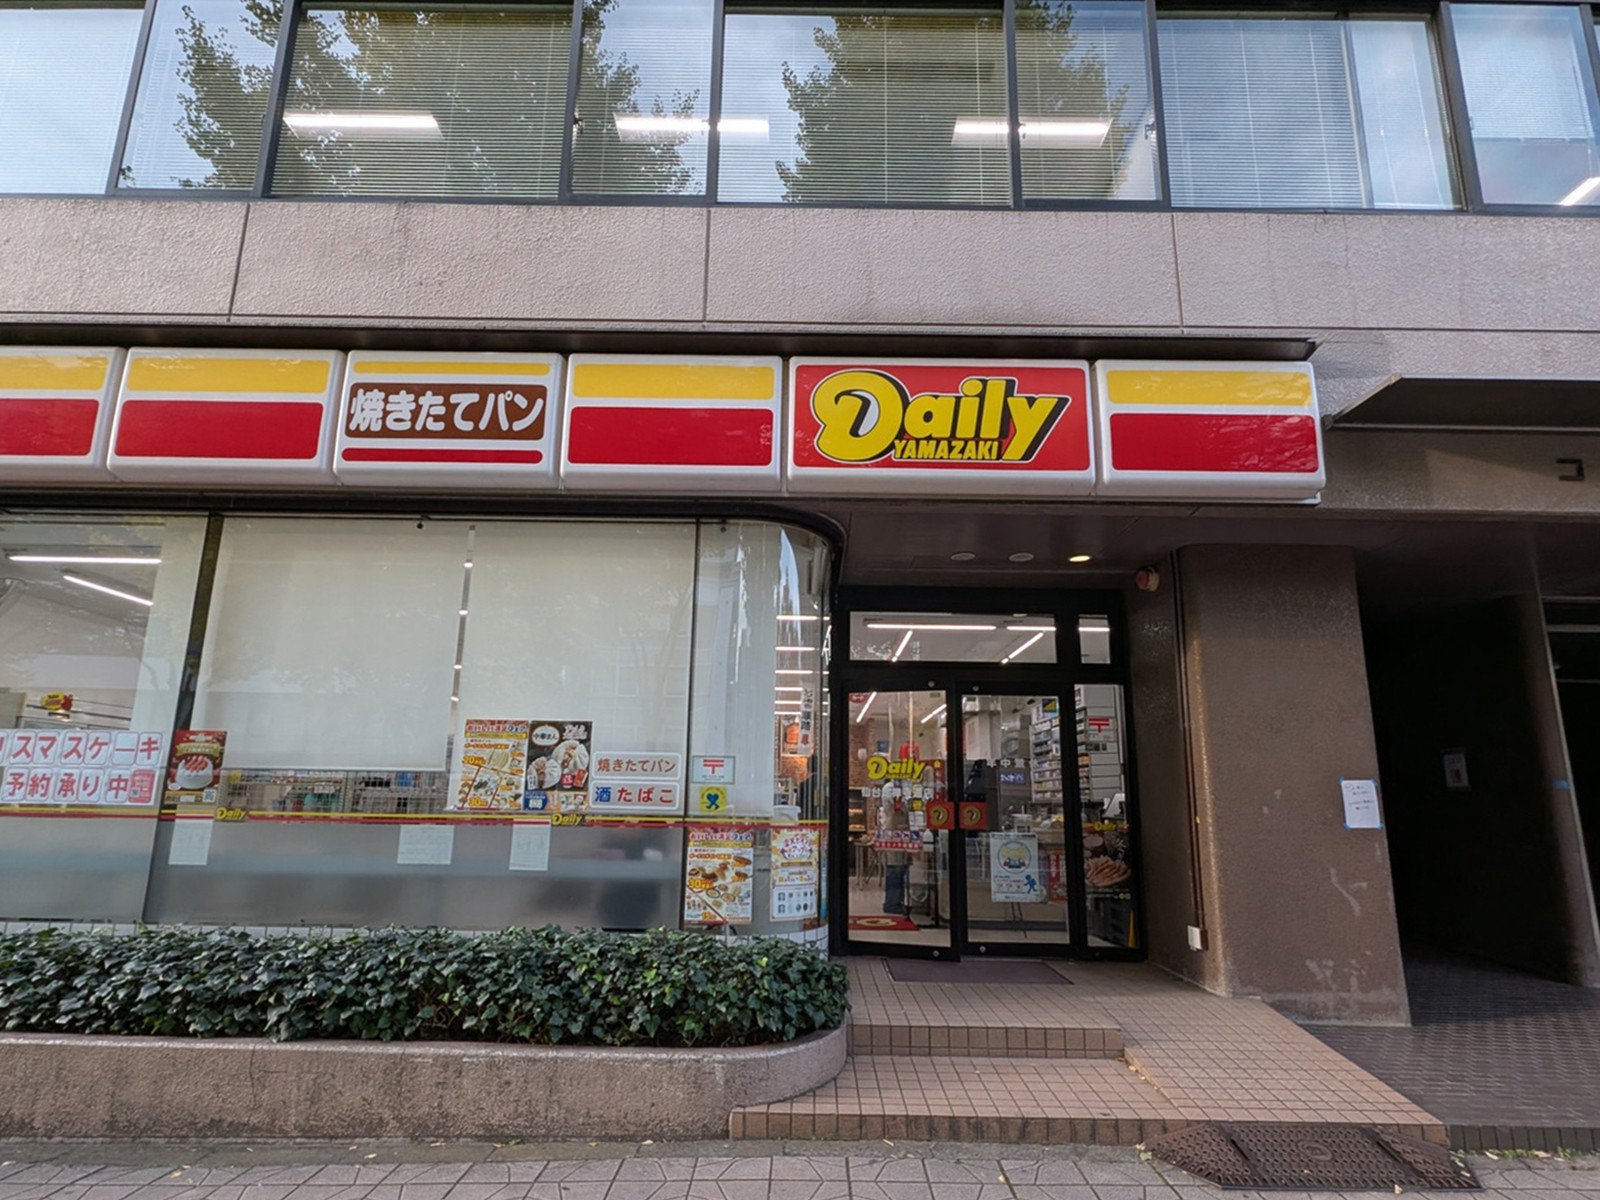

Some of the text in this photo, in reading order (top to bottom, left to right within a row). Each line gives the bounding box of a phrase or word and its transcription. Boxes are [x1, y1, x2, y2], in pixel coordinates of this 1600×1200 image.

[349, 388, 544, 432] 焼きたてパン
[812, 369, 1070, 462] Daily
[893, 439, 1000, 460] YAMAZAKI
[0, 736, 160, 760] スマスケーキ
[597, 758, 676, 773] 焼きたてパン
[866, 756, 926, 780] Daily
[6, 772, 129, 799] 予約承り中
[617, 787, 673, 803] たばこ
[217, 807, 246, 820] Daily
[552, 813, 582, 826] Daily
